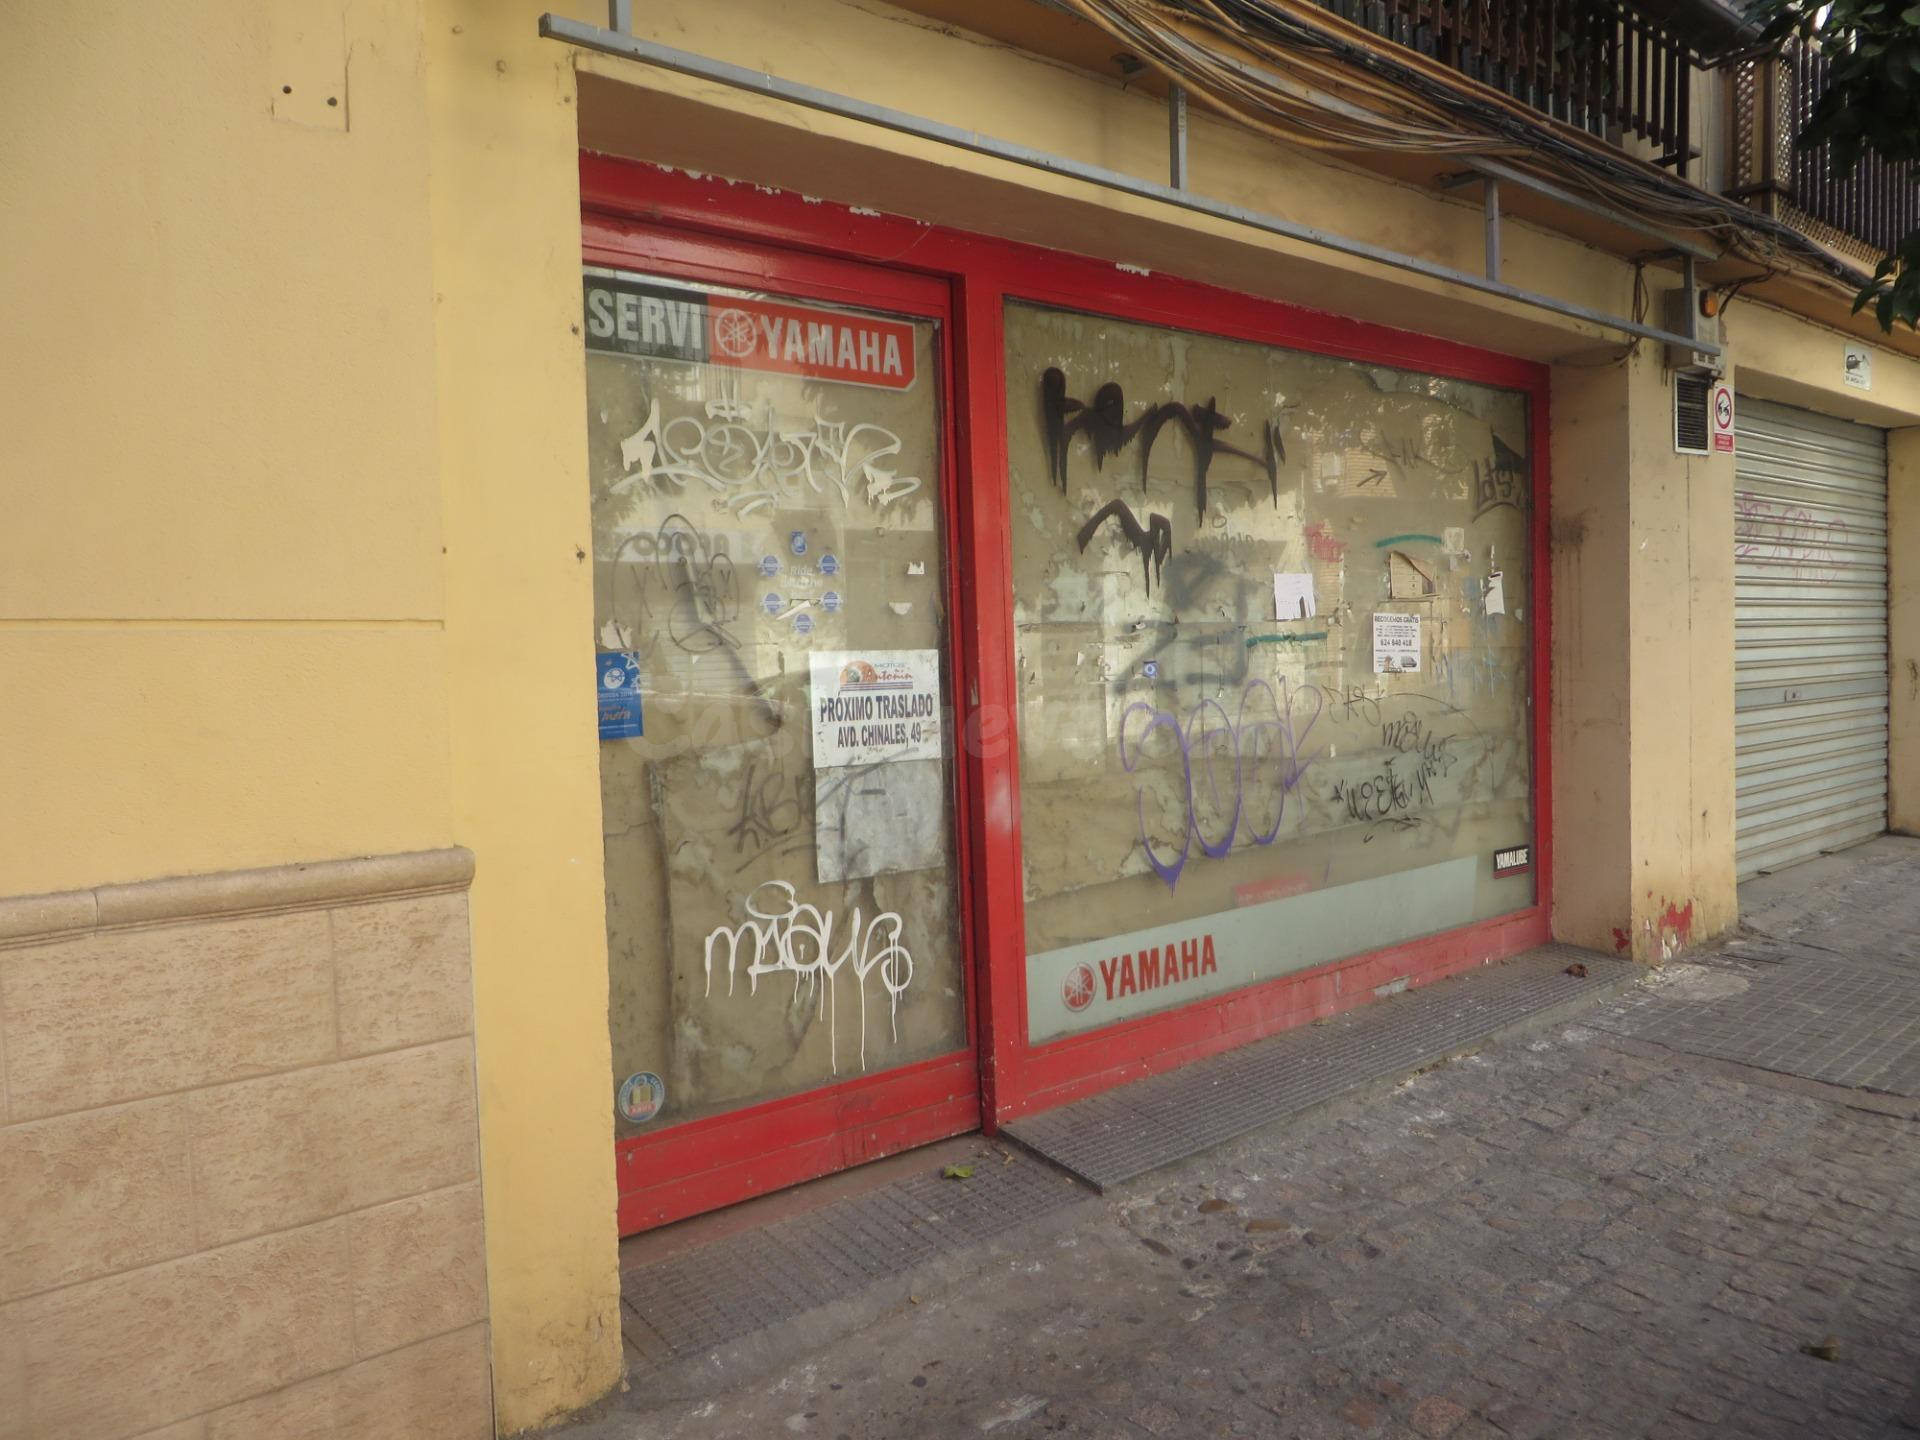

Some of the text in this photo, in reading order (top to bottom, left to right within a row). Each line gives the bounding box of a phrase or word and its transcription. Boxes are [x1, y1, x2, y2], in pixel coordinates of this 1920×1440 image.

[588, 288, 903, 375] SERVI YAMAHA
[820, 691, 933, 723] PRÓXIMO TRASLADO
[837, 722, 922, 748] AVD. CHINALES, 49
[1496, 848, 1529, 870] YAMALUBE
[1100, 935, 1217, 1000] YAMAHA
